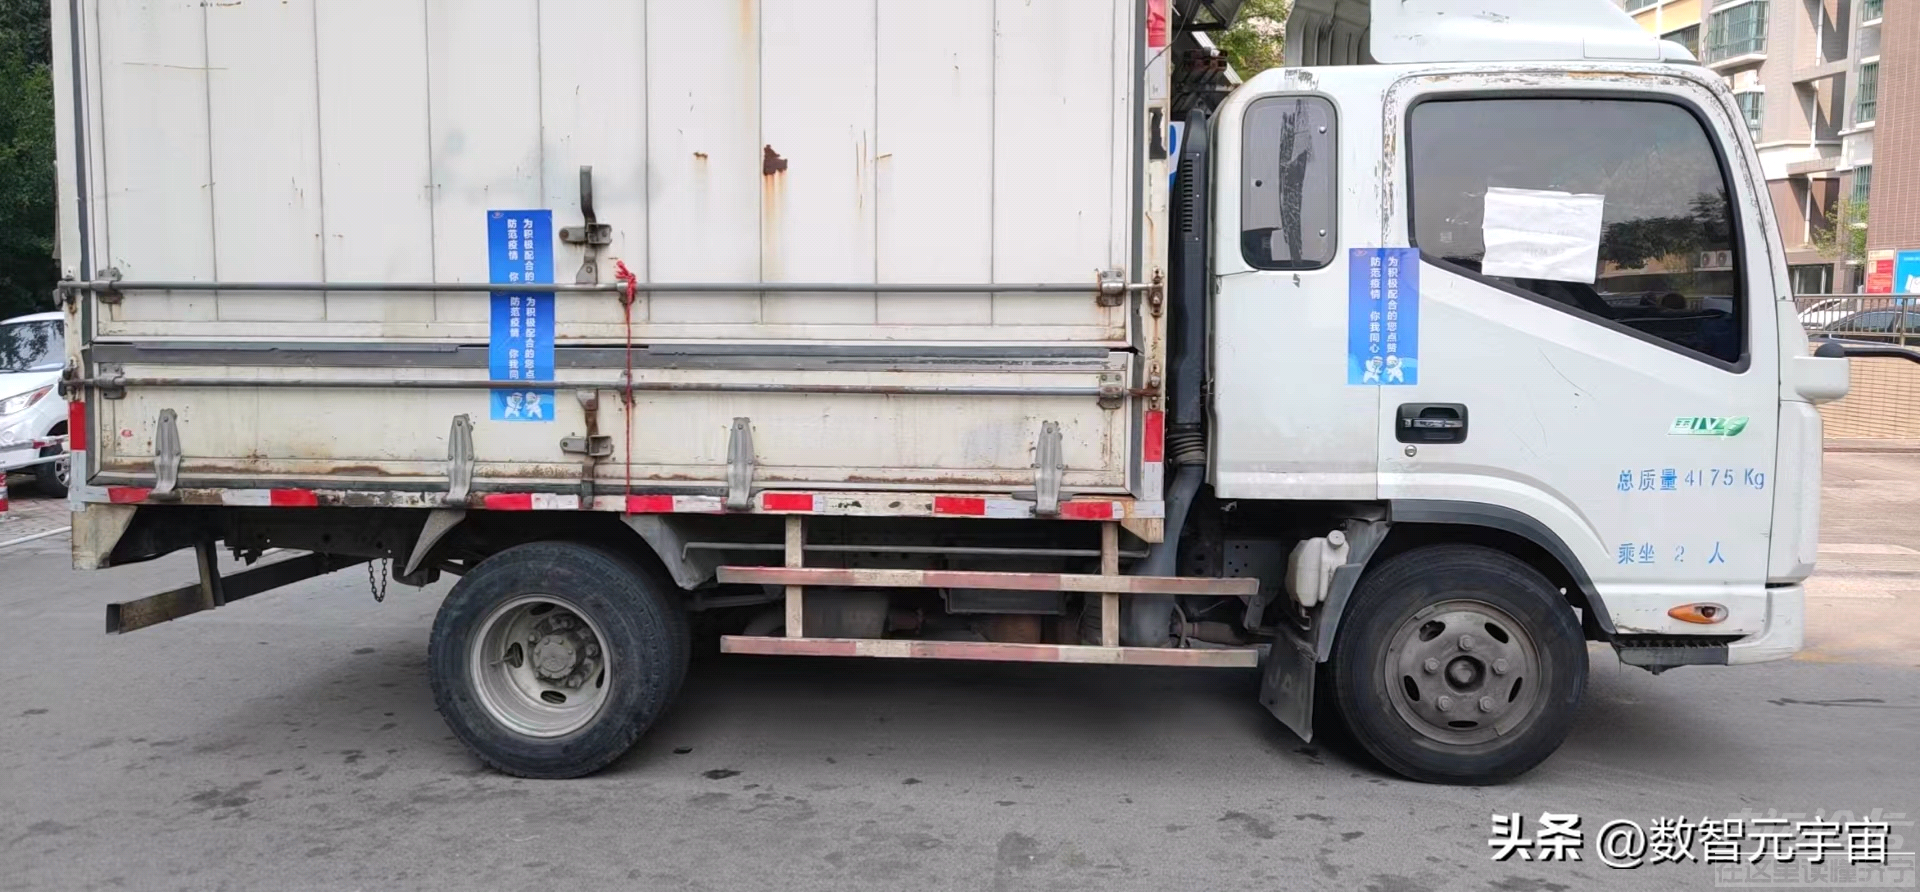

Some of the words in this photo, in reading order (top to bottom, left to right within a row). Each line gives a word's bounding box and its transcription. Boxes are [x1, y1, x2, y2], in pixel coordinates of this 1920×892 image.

[523, 218, 535, 284] 为积极配合的
